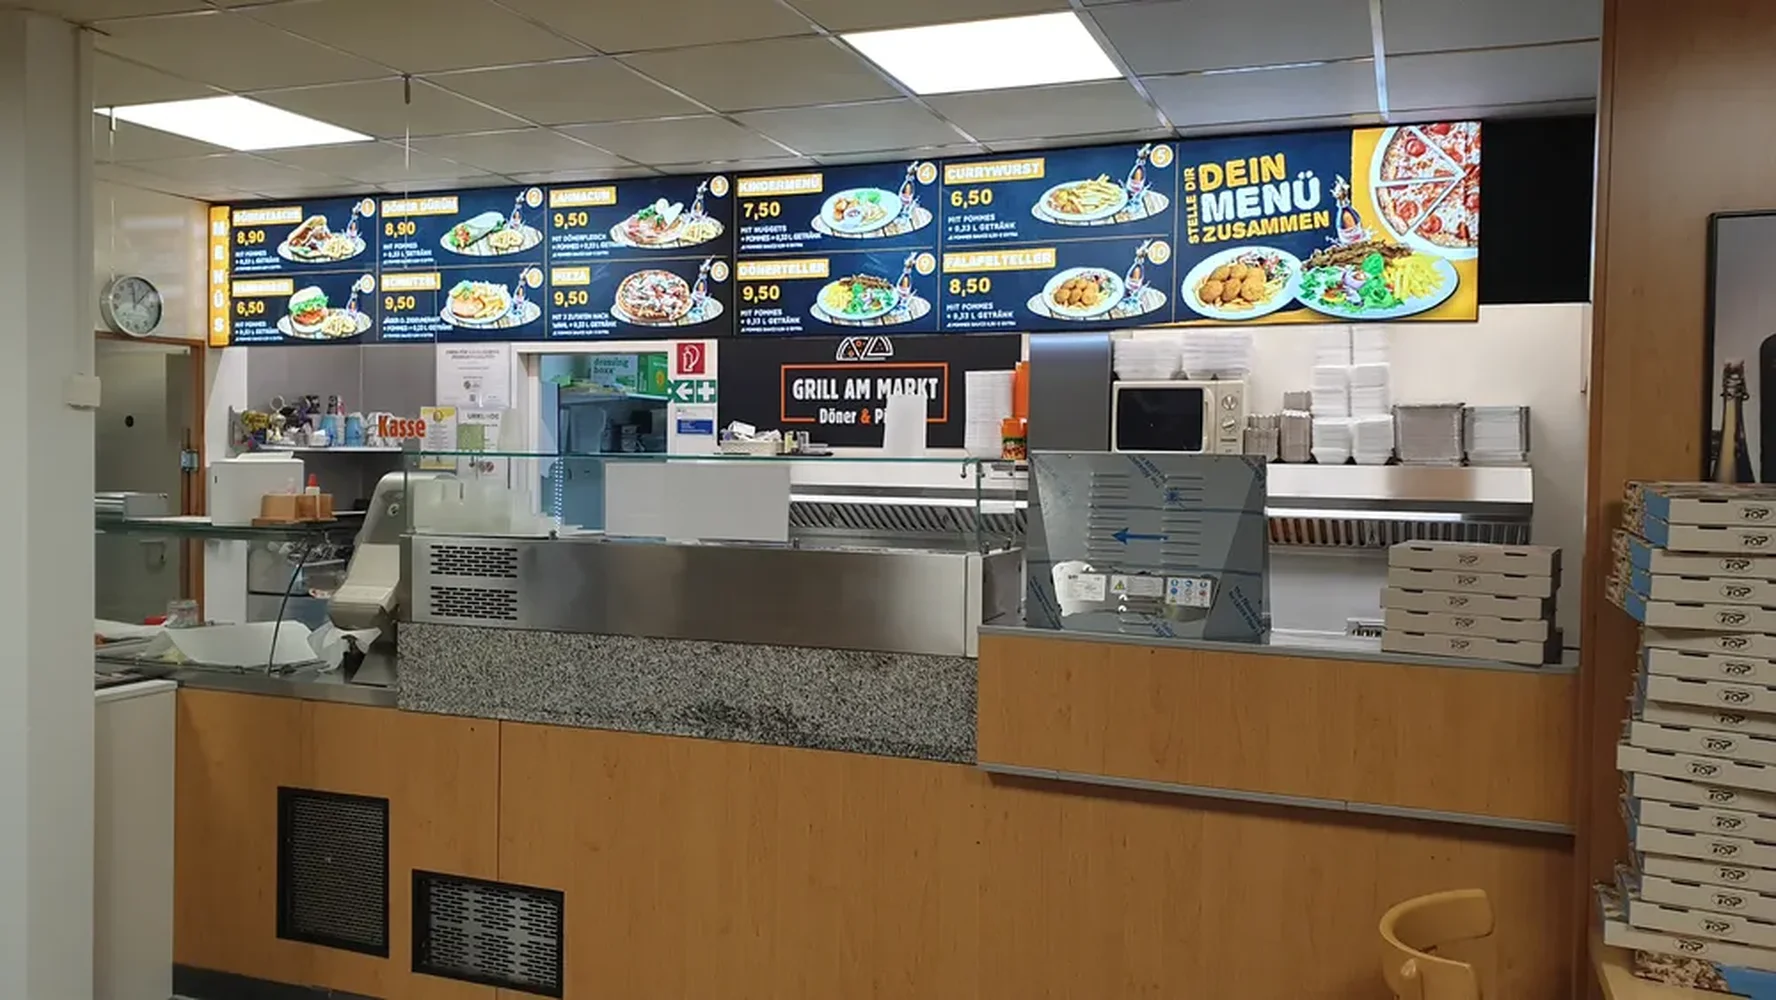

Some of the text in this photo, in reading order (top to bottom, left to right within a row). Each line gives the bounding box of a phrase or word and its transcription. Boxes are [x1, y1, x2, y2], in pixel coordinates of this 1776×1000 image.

[1157, 150, 1167, 162] 5
[922, 167, 930, 179] 4
[947, 162, 1039, 180] CURRYWURST
[1198, 153, 1287, 192] DEIN
[738, 175, 820, 192] KINDERMENÜ
[951, 189, 993, 210] 6,50
[1200, 172, 1320, 223] MENÜ
[743, 202, 781, 220] 7,50
[1185, 168, 1200, 244] STELLE DIR
[554, 213, 588, 230] 9,50
[963, 214, 995, 222] POMMES
[385, 222, 416, 238] 8,90
[979, 221, 1016, 231] GETRÄNK
[1202, 210, 1330, 243] ZUSAMMEN
[237, 231, 265, 246] 8,90
[1152, 246, 1165, 259] 10
[945, 252, 1052, 268] FALAFELTELLER
[739, 262, 826, 276] DÖNERTELLER
[949, 278, 991, 297] 8,50
[554, 291, 588, 308] 9,50
[743, 286, 780, 304] 9,50
[237, 301, 265, 317] 6,50
[385, 296, 415, 312] 9,50
[962, 302, 993, 310] POMMES
[768, 316, 800, 324] GETRÄNK
[977, 309, 1014, 319] GETRÄNK
[792, 378, 939, 400] GRILL AM MARKT
[820, 408, 856, 424] Döner
[860, 408, 870, 424] &
[378, 414, 426, 438] Kasse
[1743, 508, 1769, 520] TOP
[1742, 535, 1768, 546] TOP
[1725, 560, 1751, 571] TOP
[1726, 586, 1752, 598] TOP
[1720, 613, 1746, 624] TOP
[1722, 637, 1748, 649] TOP
[1726, 664, 1752, 675] TOP
[1724, 691, 1750, 703] TOP
[1720, 713, 1746, 724] TOP
[1707, 740, 1733, 751] TOP
[1691, 764, 1718, 776] TOP
[1708, 790, 1734, 801] TOP
[1715, 816, 1742, 828] TOP
[1712, 844, 1738, 856] TOP
[1720, 868, 1746, 880] TOP
[1717, 895, 1743, 908] TOP
[1705, 920, 1731, 932] TOP
[1678, 940, 1704, 952] TOP
